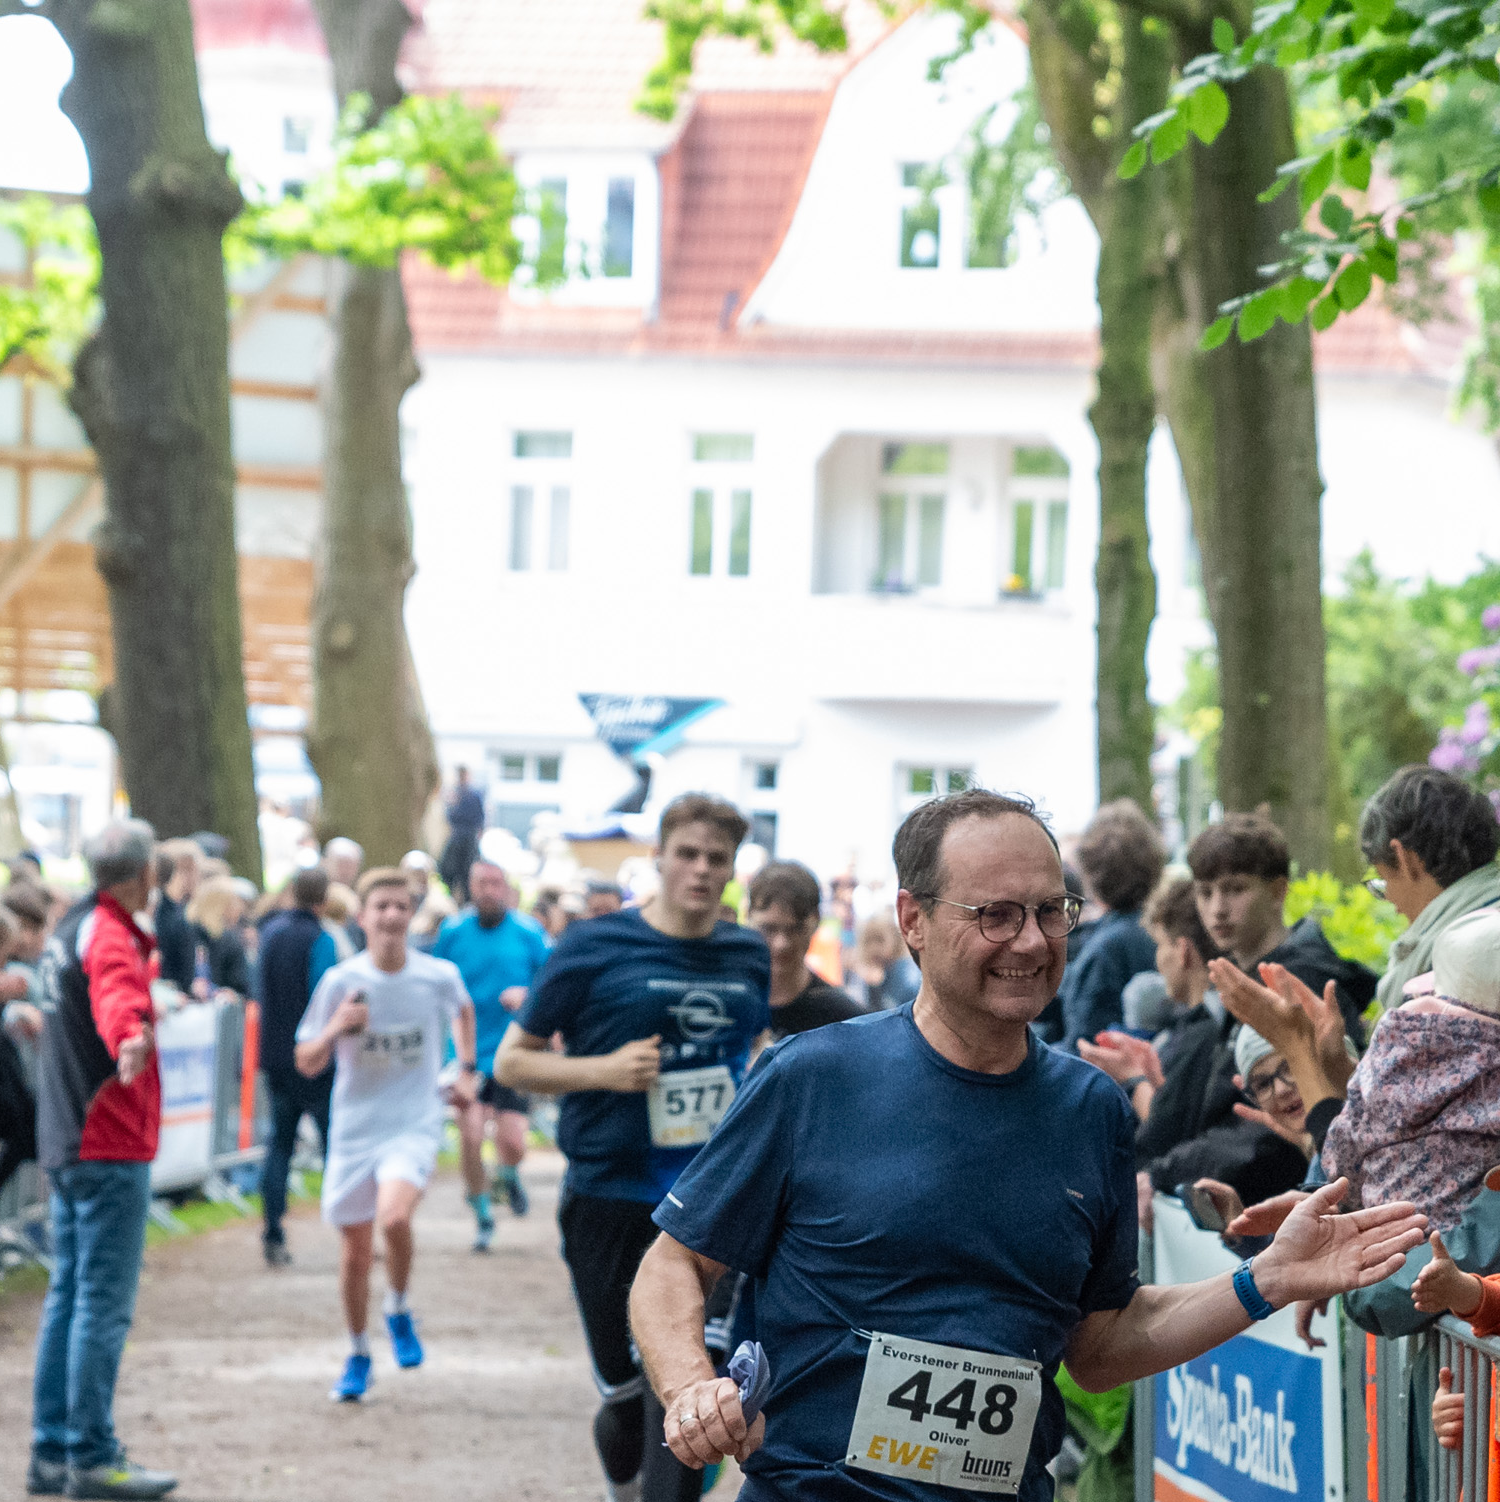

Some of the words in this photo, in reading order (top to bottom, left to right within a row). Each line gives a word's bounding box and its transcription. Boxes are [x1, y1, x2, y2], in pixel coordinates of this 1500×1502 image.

[666, 1083, 726, 1116] 577
[882, 1345, 960, 1371] Everstener
[962, 1361, 1035, 1382] Brunnenlauf
[887, 1371, 1017, 1435] 448
[866, 1434, 940, 1471] EWE
[929, 1430, 970, 1447] Oliver
[962, 1450, 1013, 1478] bruns
